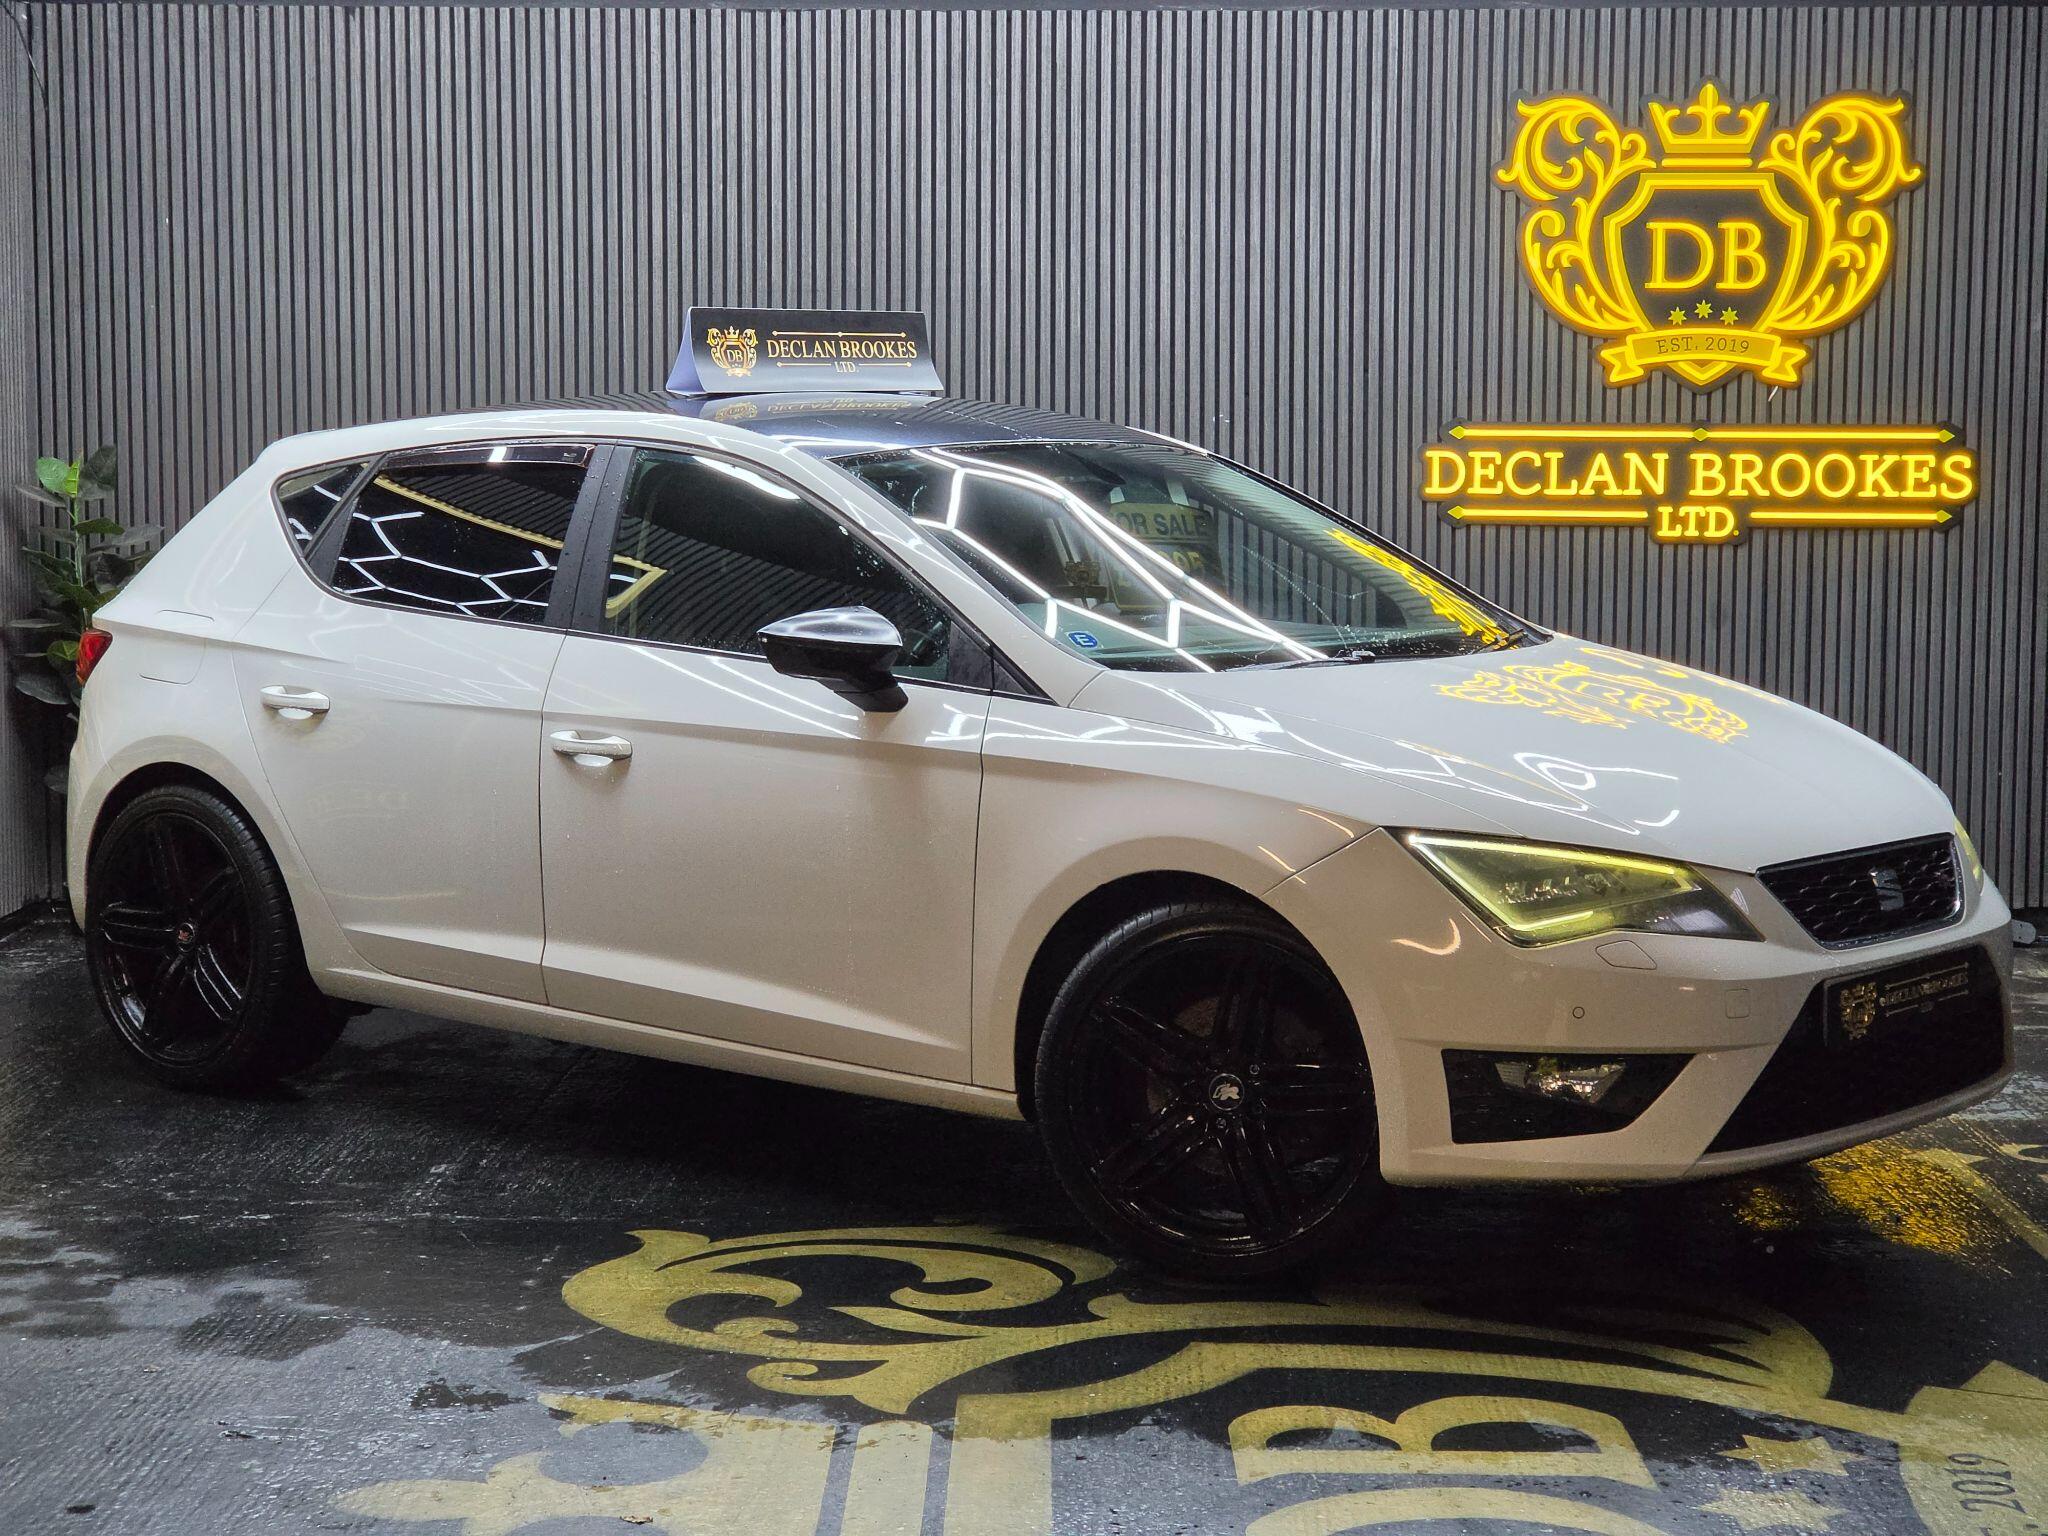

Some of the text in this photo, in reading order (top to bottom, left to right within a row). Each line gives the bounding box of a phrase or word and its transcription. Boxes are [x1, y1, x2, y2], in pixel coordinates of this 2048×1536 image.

[1644, 220, 1767, 290] DB
[726, 349, 744, 362] DB
[766, 338, 918, 359] DECLAN BROOKES
[1656, 336, 1750, 354] EST. 2019
[1425, 450, 1974, 498] DECLAN BROOKES
[1656, 505, 1739, 537] LTD.
[1944, 1453, 2026, 1514] 2019
